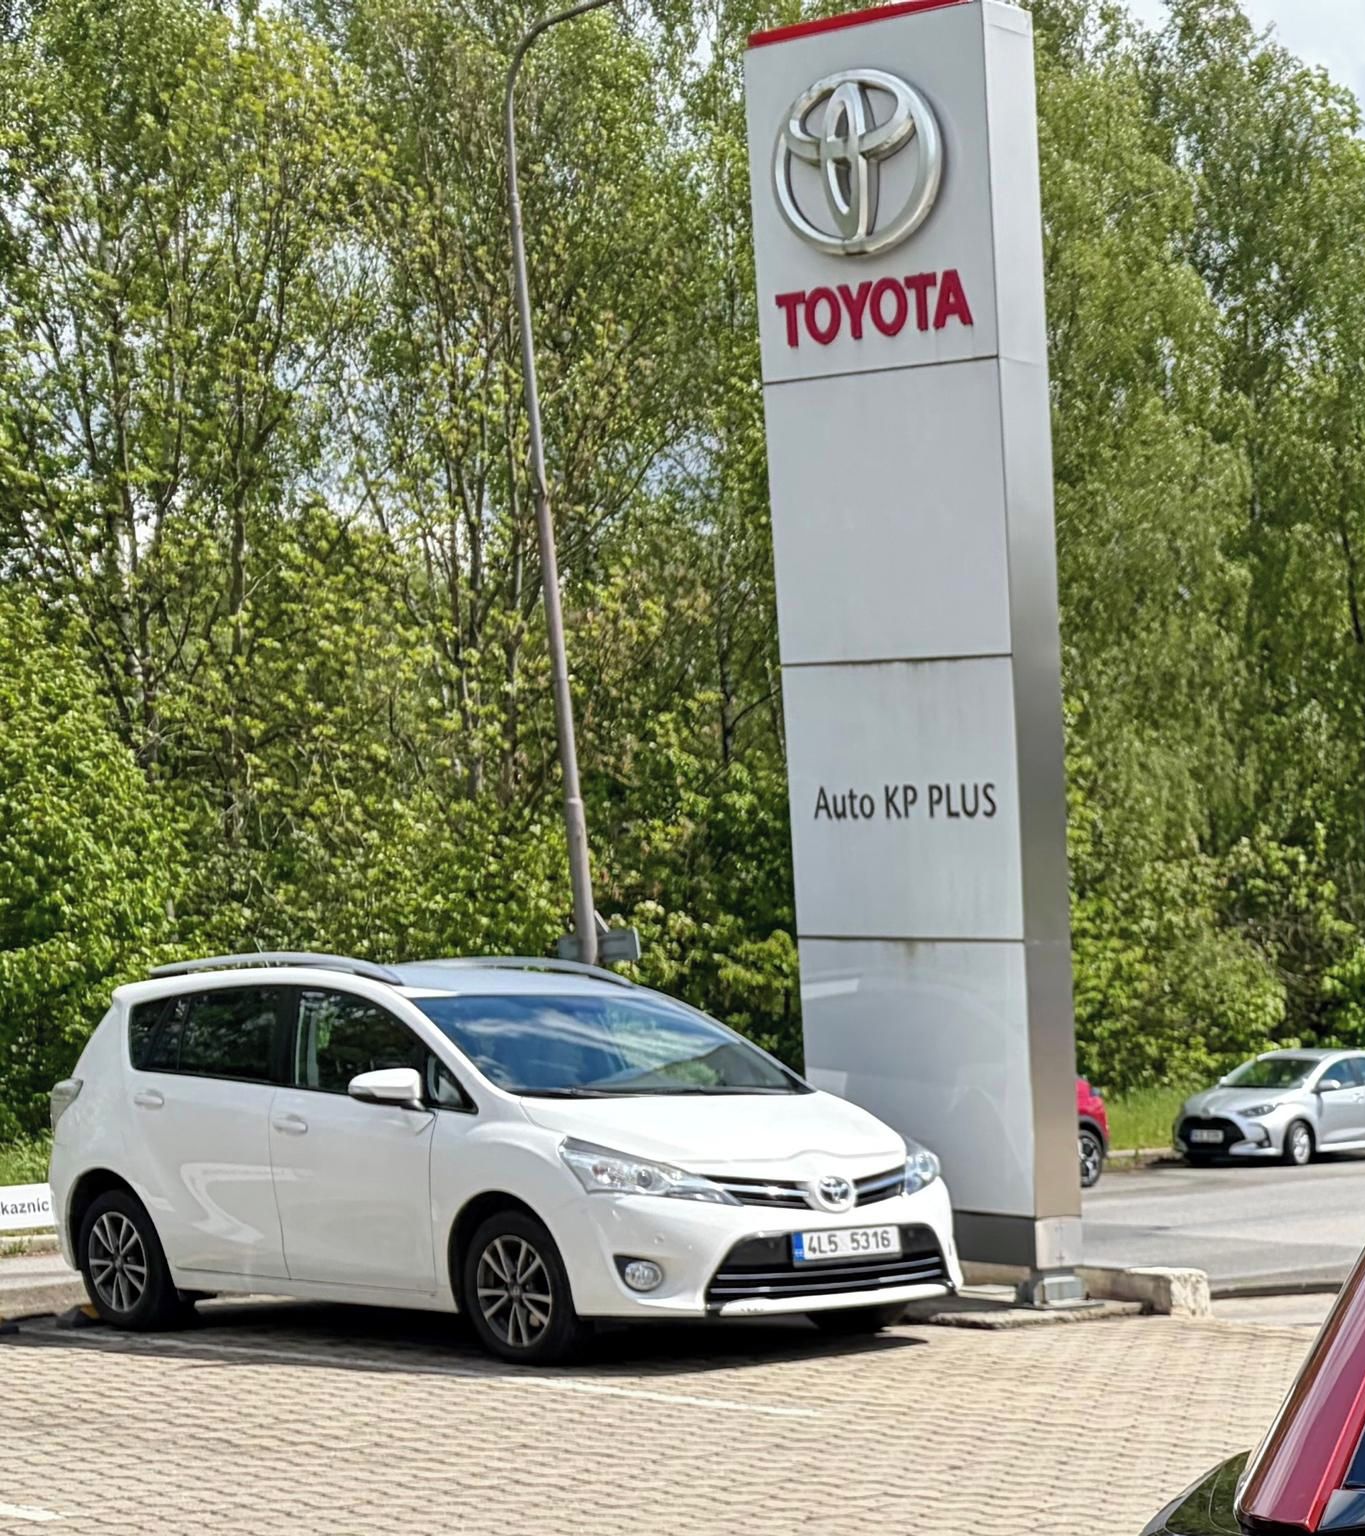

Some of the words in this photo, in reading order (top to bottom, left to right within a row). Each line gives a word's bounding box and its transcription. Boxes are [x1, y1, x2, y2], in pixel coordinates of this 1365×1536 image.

[775, 269, 973, 348] TOYOTA
[814, 785, 875, 820] Auto
[884, 784, 917, 818] KP
[928, 783, 997, 818] PLUS
[808, 1233, 838, 1254] 4L5
[849, 1229, 891, 1251] 5316
